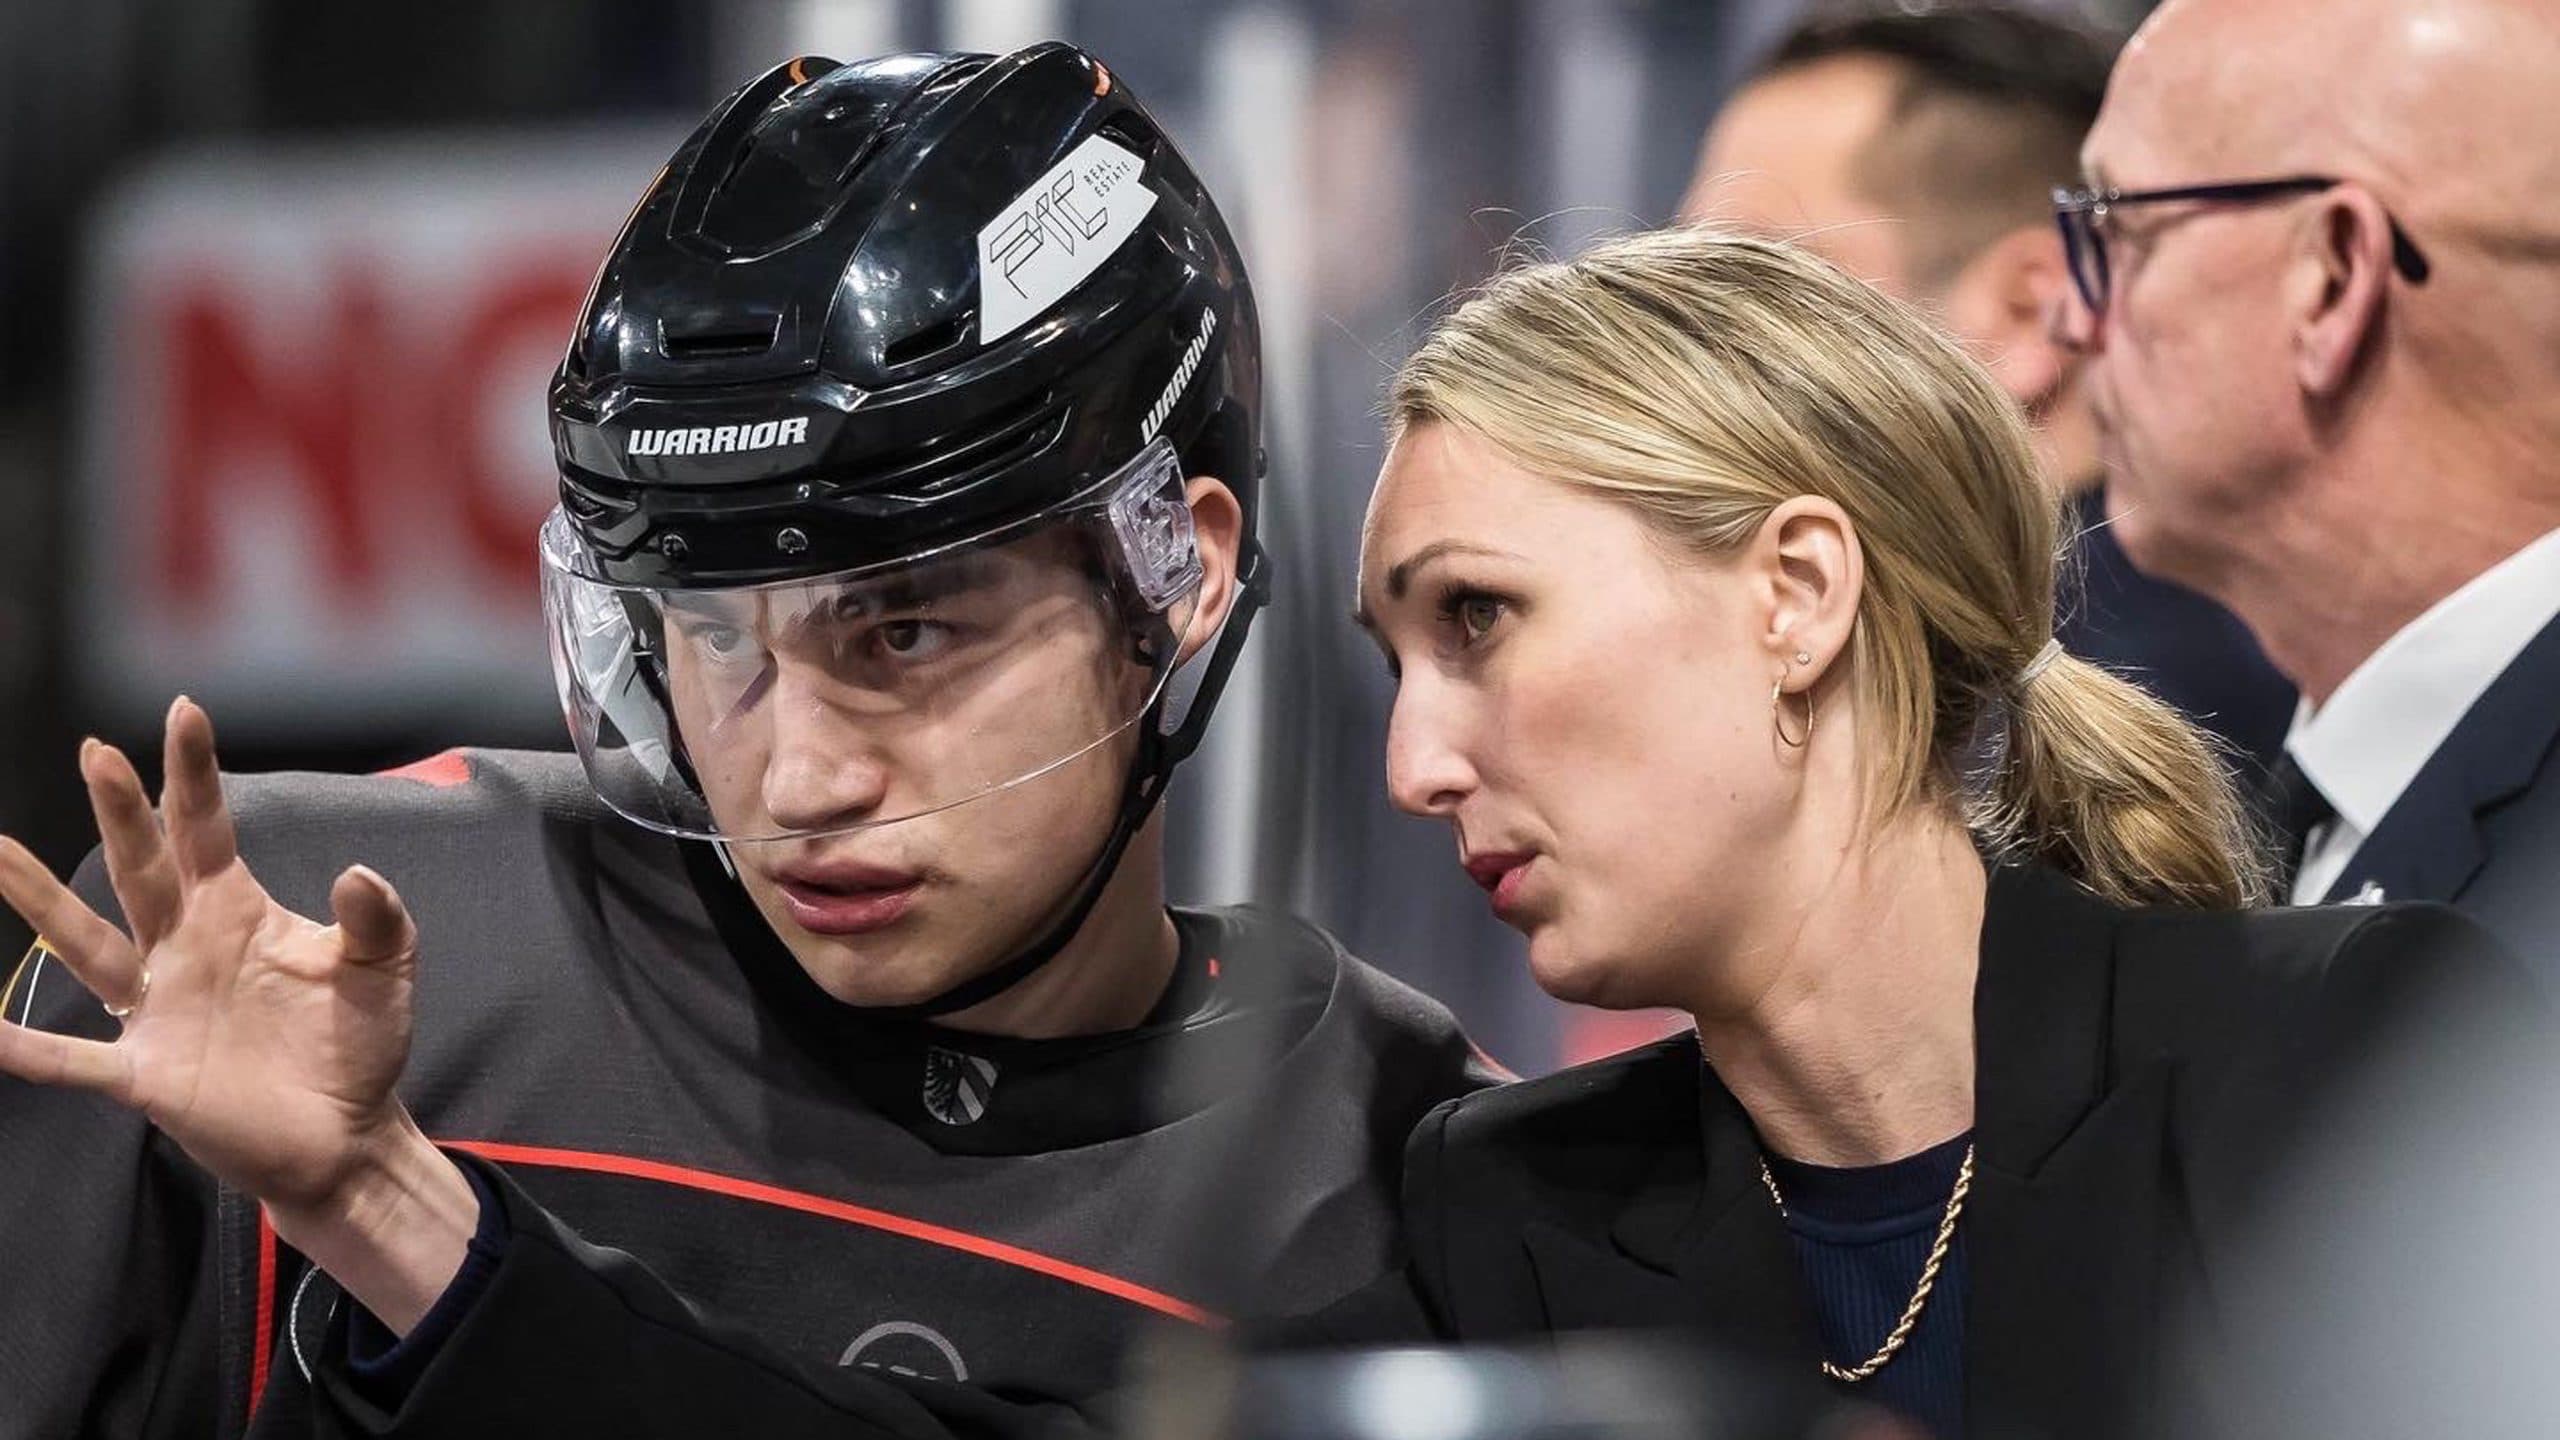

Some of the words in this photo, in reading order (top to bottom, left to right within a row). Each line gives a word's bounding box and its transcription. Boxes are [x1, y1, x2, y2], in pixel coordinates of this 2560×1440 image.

[1083, 159, 1111, 186] REAL
[1094, 160, 1131, 198] ESTATE
[628, 416, 809, 456] WARRIOR
